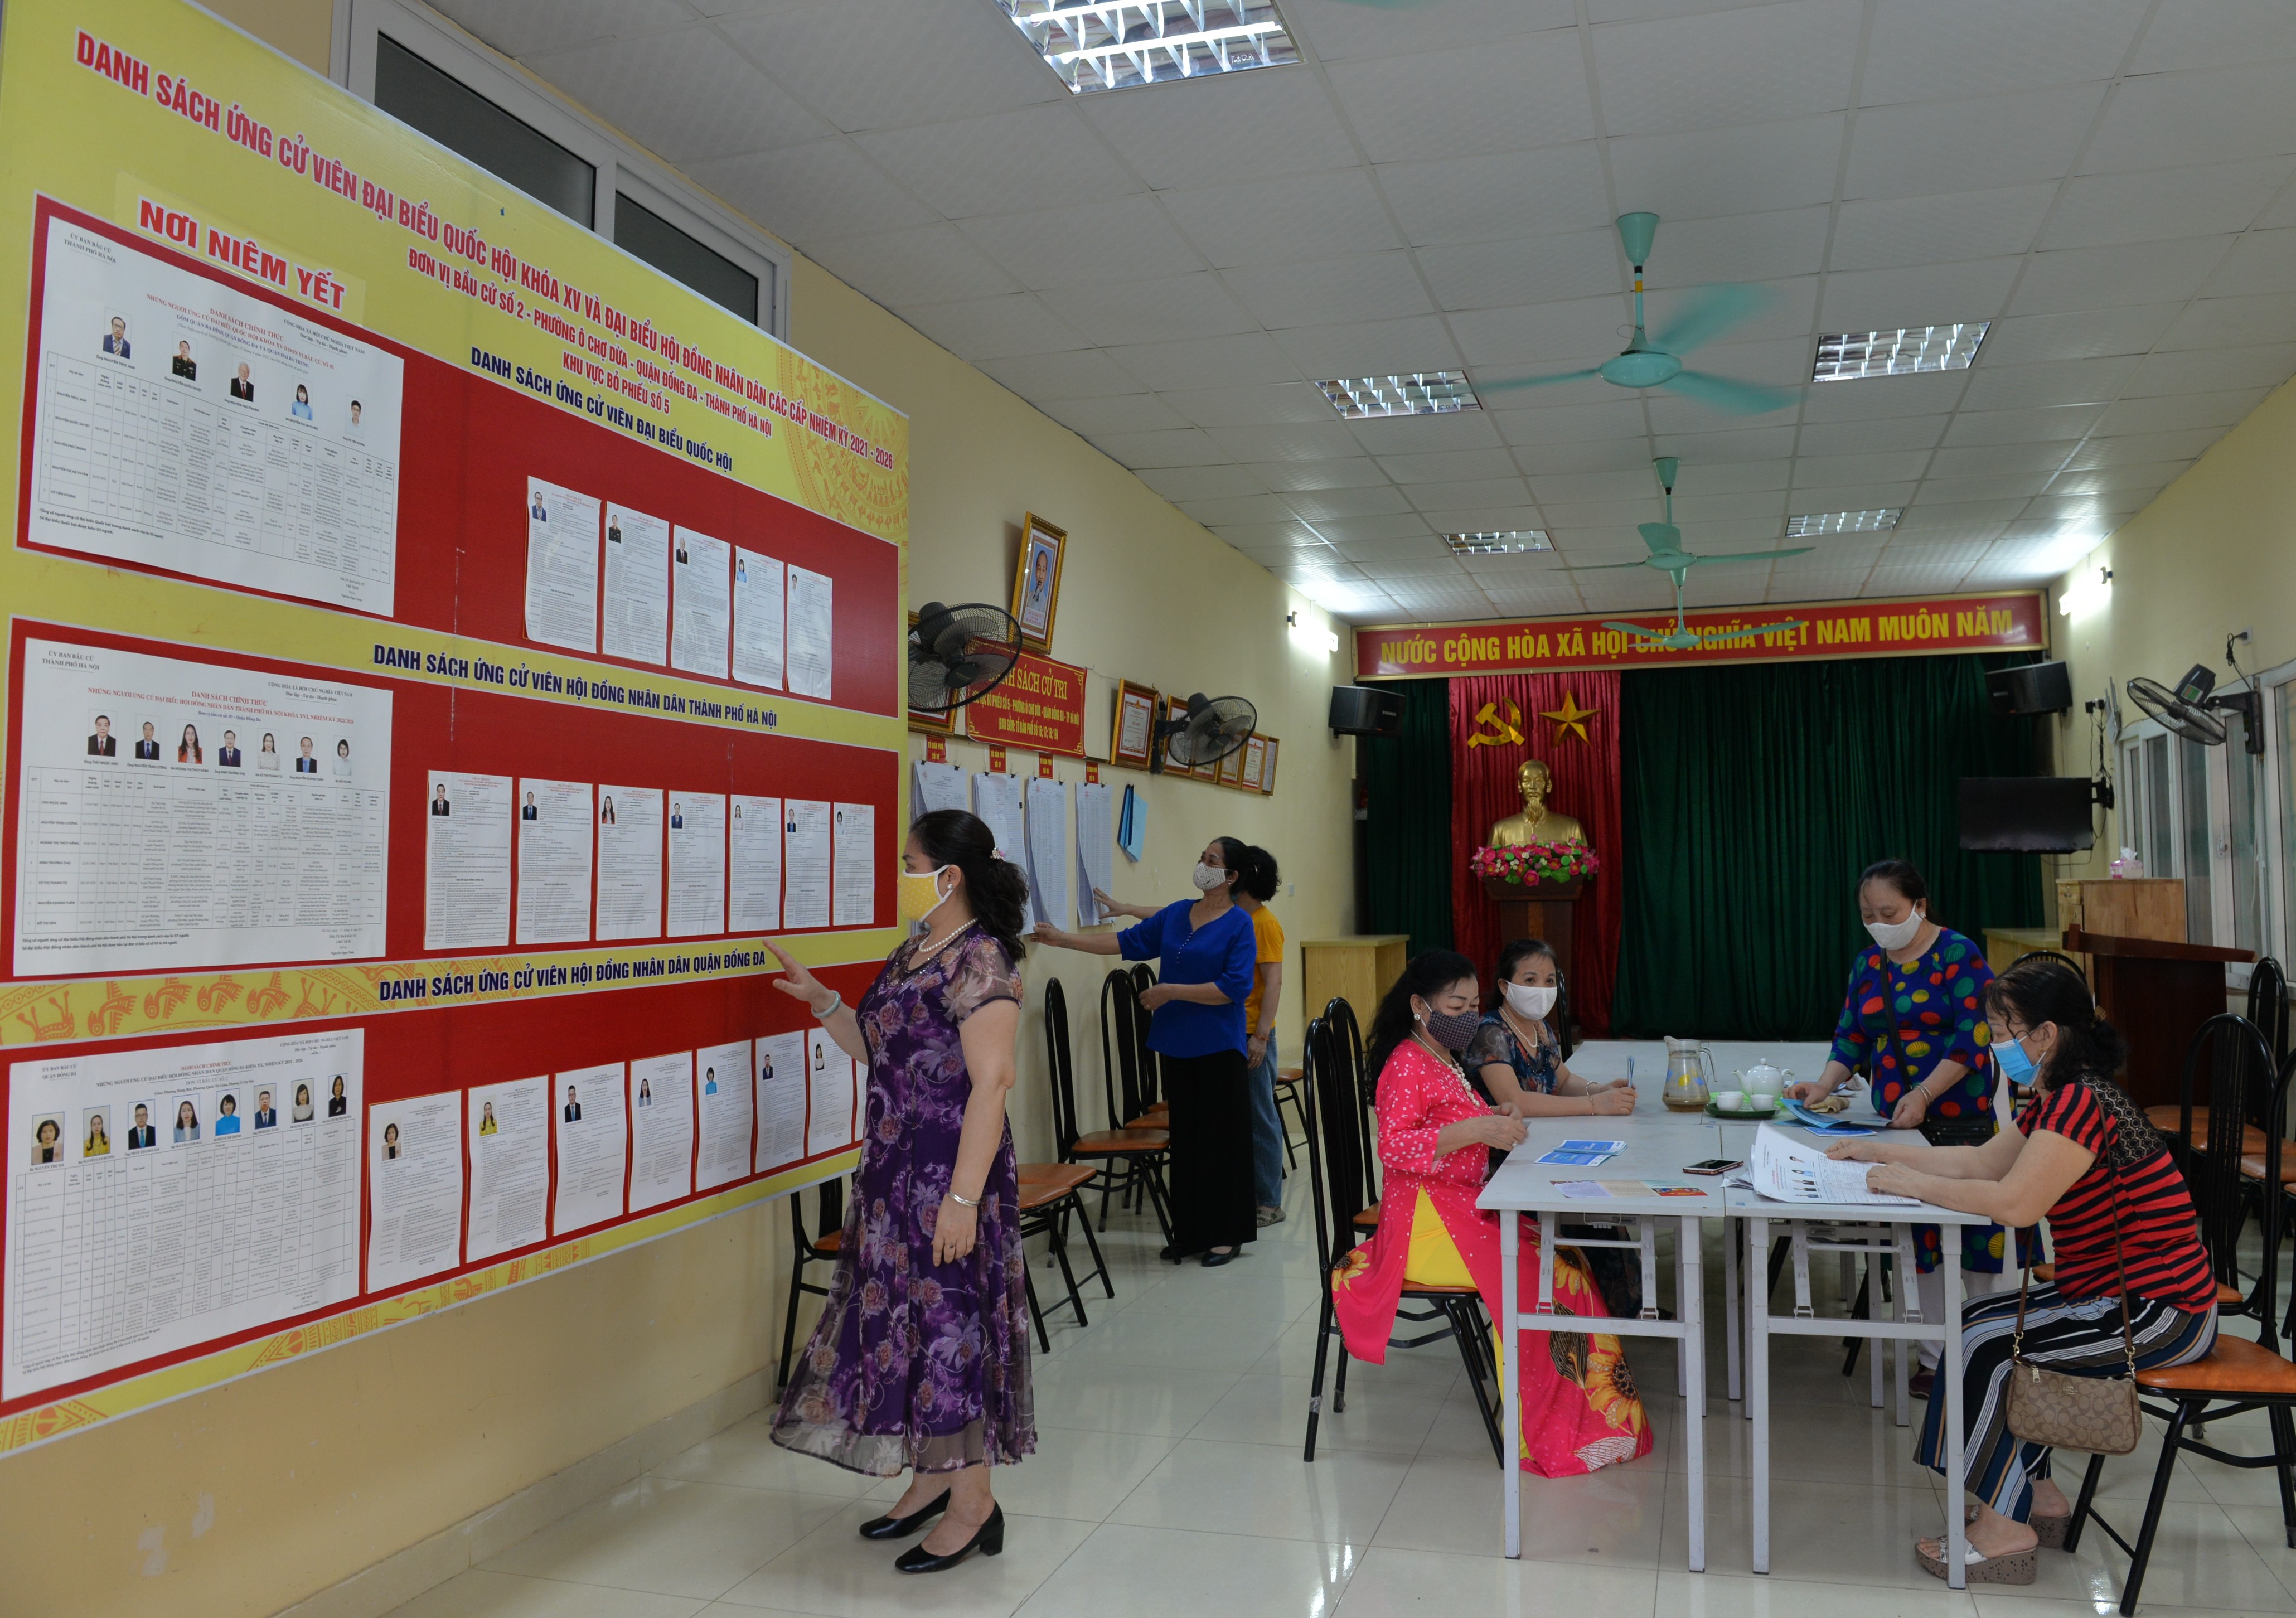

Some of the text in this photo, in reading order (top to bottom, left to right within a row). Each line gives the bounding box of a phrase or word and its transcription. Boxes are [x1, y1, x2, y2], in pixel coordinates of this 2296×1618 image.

[78, 31, 893, 470] DANH SÁCH ỨNG CỬ VIÊN ĐẠI BIỂU QUỐC HỘI KHÓA XV VÀ ĐẠI BIỂU HỘI ĐỒNG NHÂN DÂN CÁC CẤP NHIỆM KỲ 2021 2026
[140, 200, 345, 309] NƠI NIÊM YẾT
[409, 248, 772, 438] ĐƠN VỊ BẦU CỬ SỐ 2 PHƯỜNG Ô CHỢ DỪA QUẬN ĐỐNG ĐA THÀNH PHỐ HÀ NỘI
[563, 351, 670, 414] KHU VỰC BỎ PHIẾU SỐ 5
[471, 347, 732, 473] DANH SÁCH ỨNG CỬ VIÊN ĐẠI BIỂU QUỐC HỘI
[1381, 633, 1437, 664] NƯỚC
[1444, 633, 1500, 667] CỘNG
[1507, 628, 1551, 660] HÒA
[1557, 627, 1586, 657] XÃ
[1592, 626, 1627, 660] HỘI
[1687, 619, 1756, 651] NGHĨA
[1762, 616, 1809, 651] VIỆT
[1817, 617, 1871, 645] NAM
[1878, 608, 1949, 641] MUÔN
[1956, 605, 2012, 637] NĂM
[374, 644, 777, 729] DANH SÁCH ỨNG CỬ VIÊN HỘI ĐỒNG NHÂN DÂN THÀNH PHỐ HÀ NỘI
[1017, 663, 1040, 692] SÁCH
[1042, 667, 1053, 695] CỬ
[1054, 680, 1068, 700] TRI
[380, 948, 766, 1001] DANH SÁCH ỨNG CỬ VIÊN HỘI ĐỒNG NHÂN DÂN QUẬN ĐỐNG ĐA
